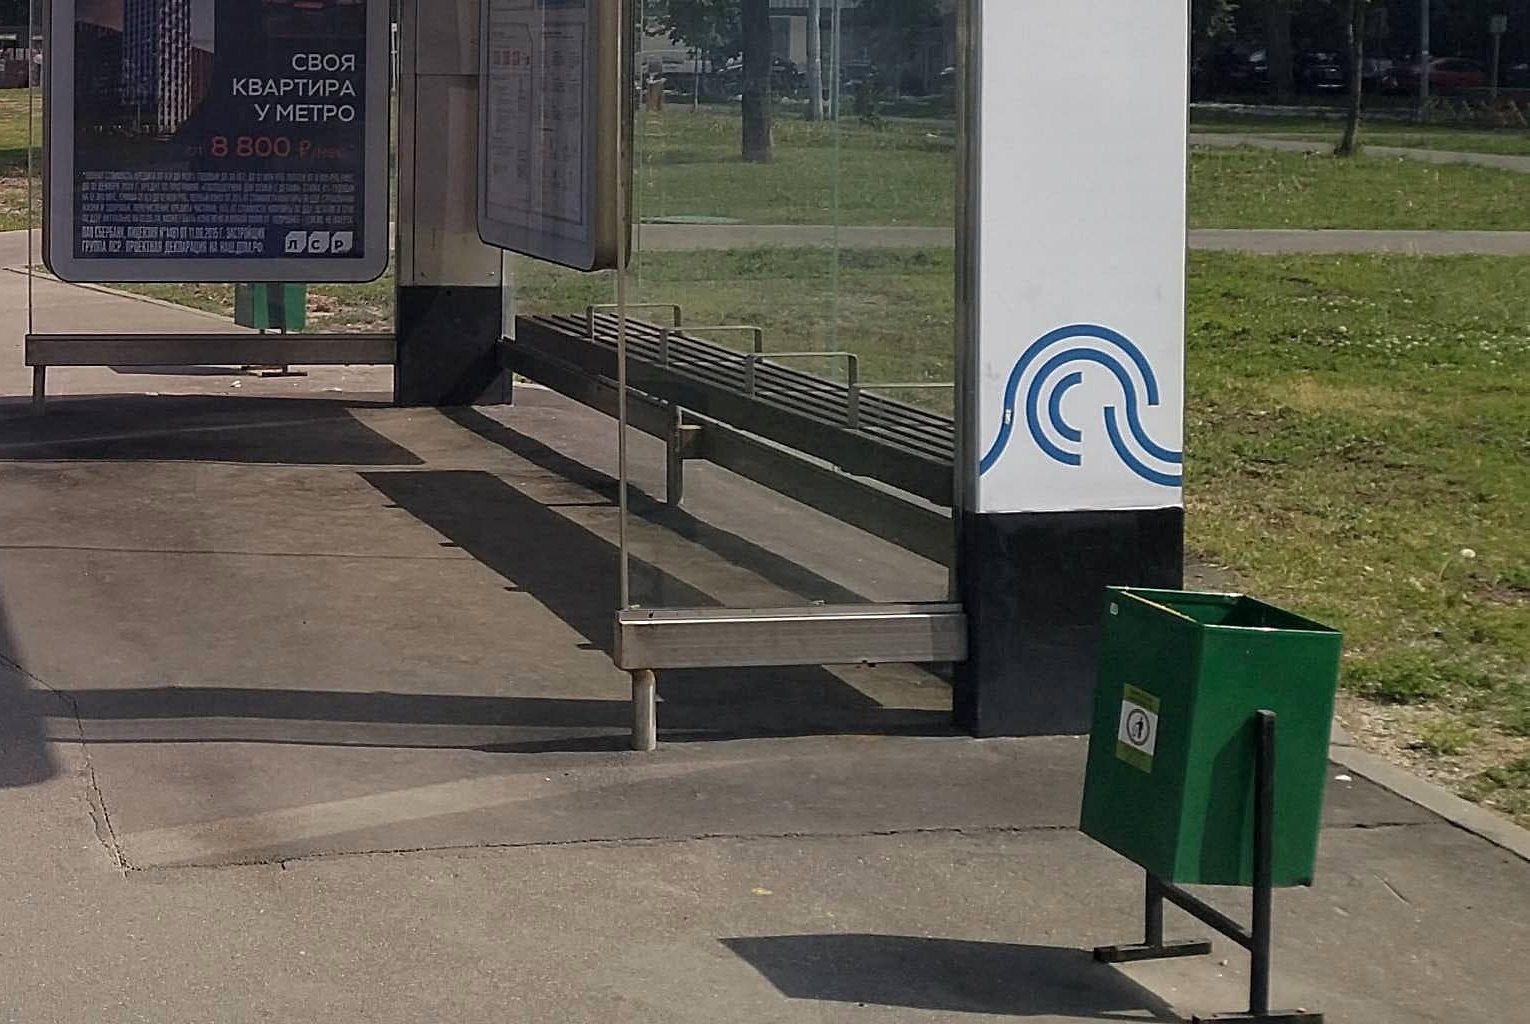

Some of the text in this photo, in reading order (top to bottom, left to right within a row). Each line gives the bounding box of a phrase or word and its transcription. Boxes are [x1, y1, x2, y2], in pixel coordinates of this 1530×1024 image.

[292, 54, 356, 72] СВОЯ
[232, 78, 356, 97] КВАРТИРА
[254, 104, 356, 122] У МЕТРО
[211, 136, 230, 157] 8
[236, 136, 291, 157] 800
